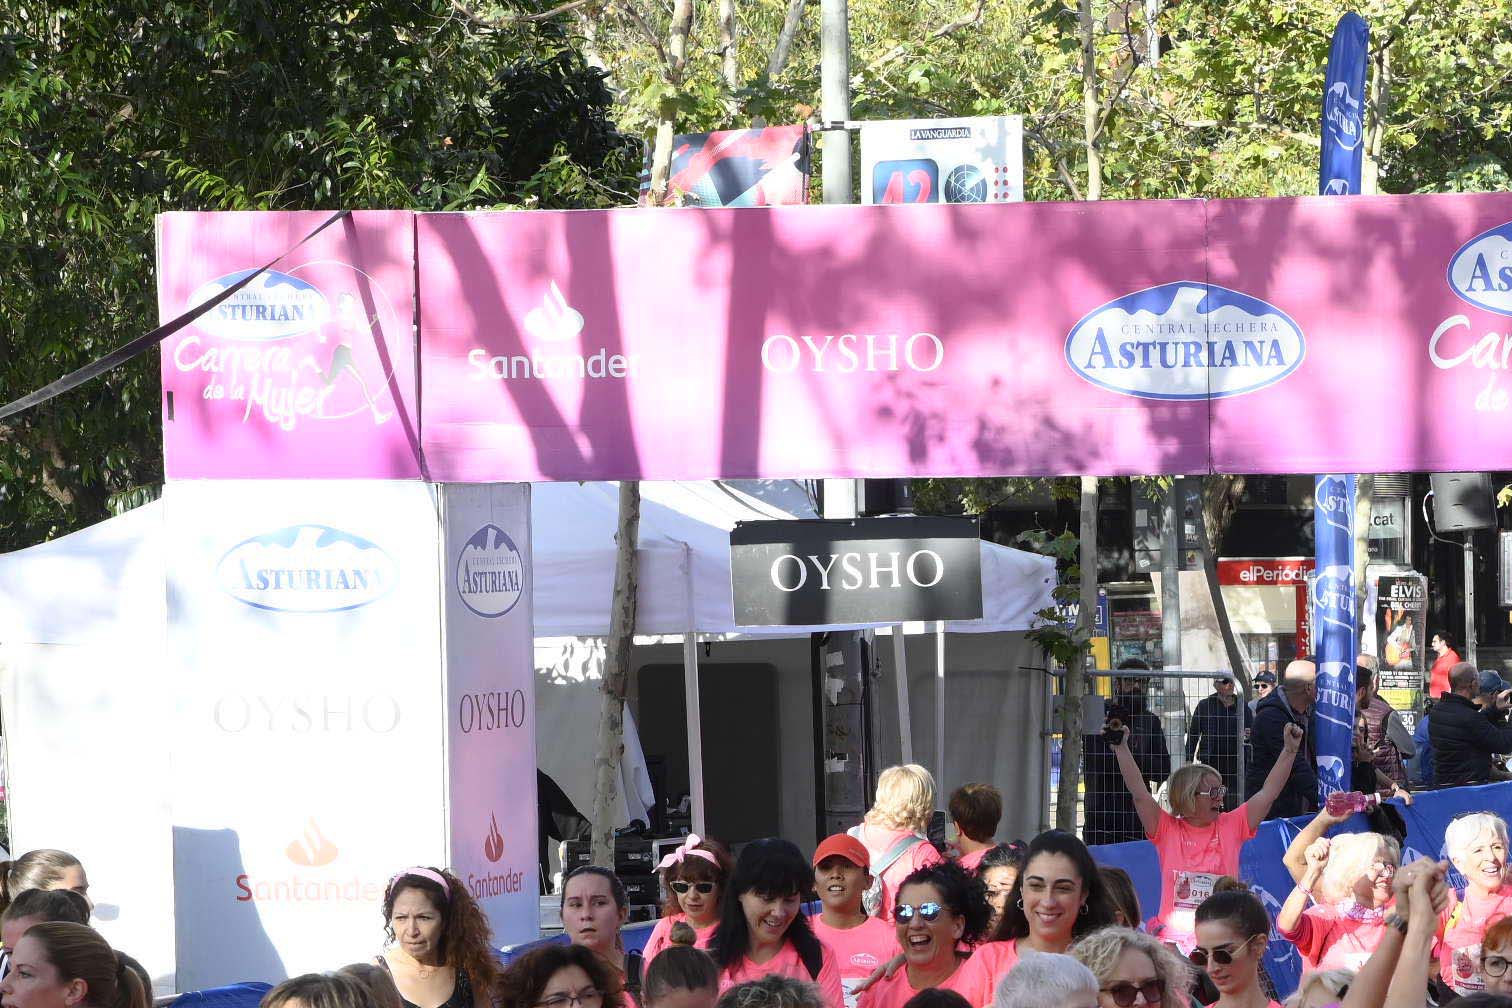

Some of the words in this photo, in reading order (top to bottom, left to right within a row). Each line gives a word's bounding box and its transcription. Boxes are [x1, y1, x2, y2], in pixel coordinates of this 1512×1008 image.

[921, 128, 970, 139] VANGUARDIA
[218, 303, 304, 321] STURIAN
[1120, 322, 1194, 335] CENTRAL
[1203, 320, 1280, 334] LECHERA
[467, 348, 638, 380] Santander
[760, 333, 944, 373] OYSHO
[1083, 327, 1286, 370] ASTURIANA
[1474, 376, 1509, 412] de
[462, 559, 520, 594] ASTURIANA
[770, 549, 944, 592] OYSHO
[1390, 585, 1423, 598] ELVIS
[213, 694, 401, 735] OYSHO
[459, 688, 525, 734] OYSHO
[467, 867, 523, 901] Santander
